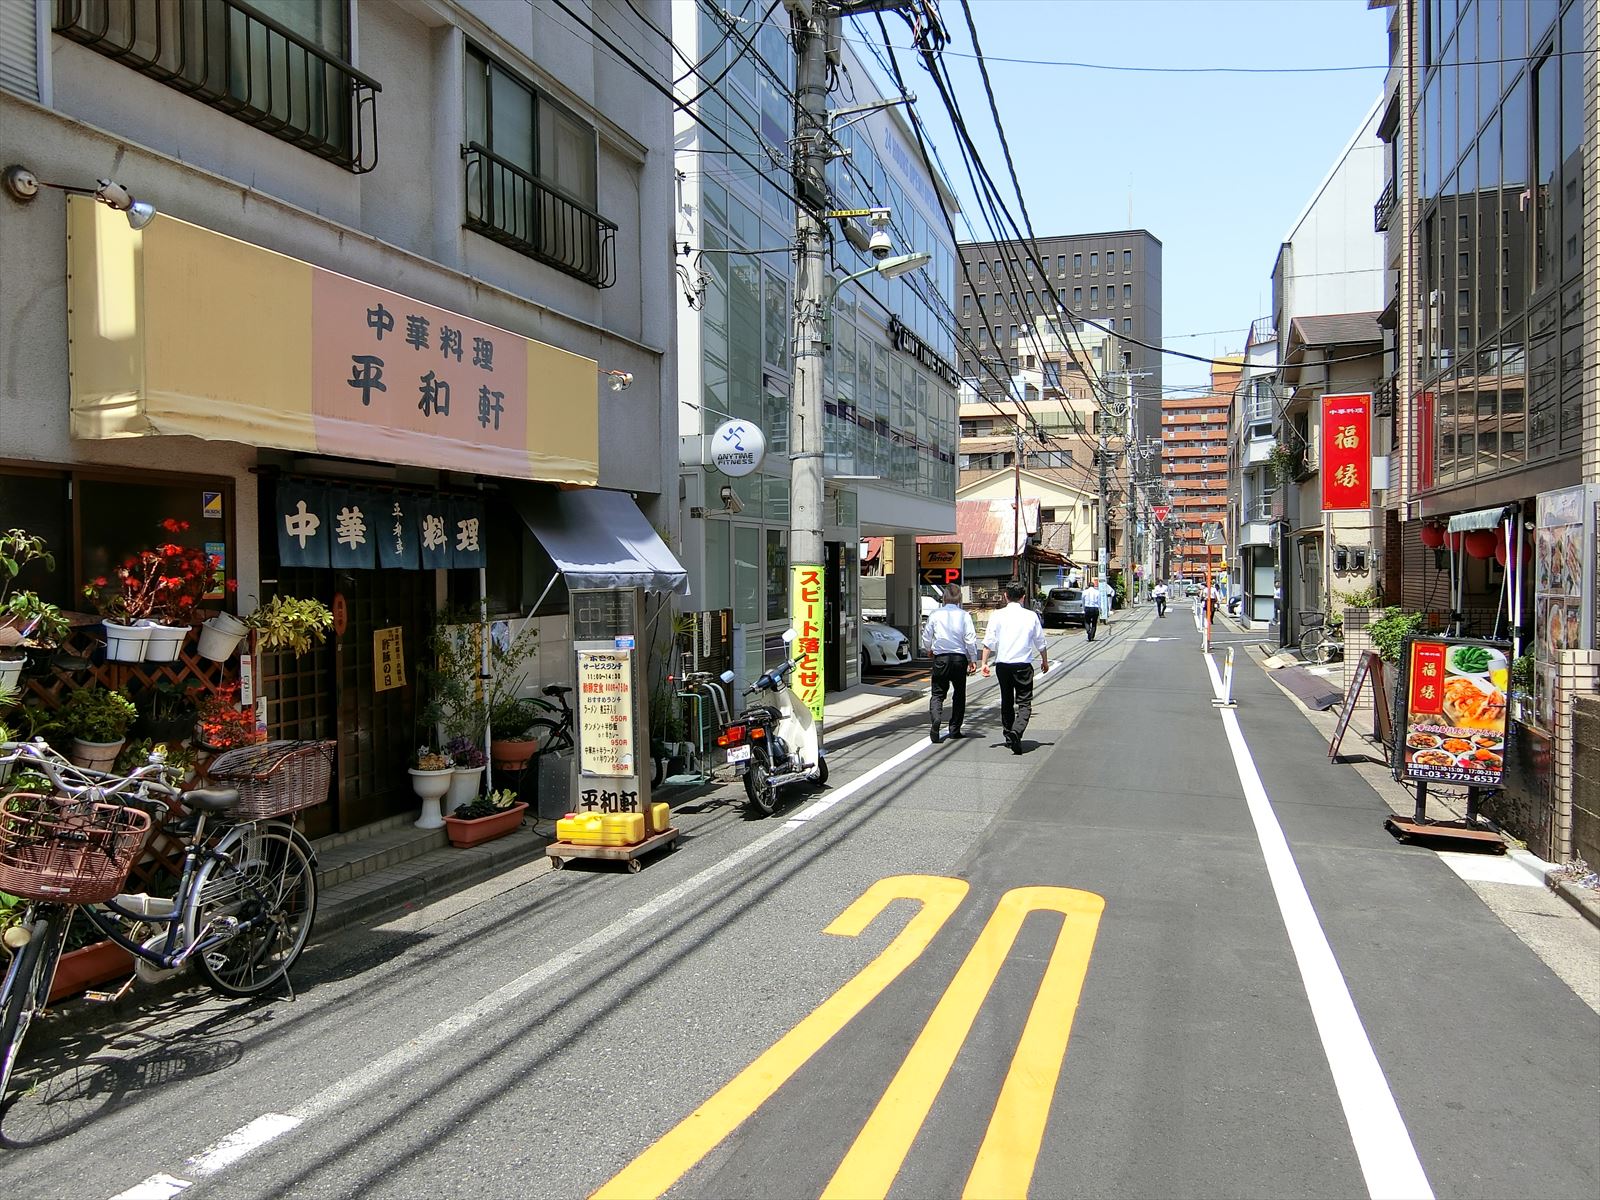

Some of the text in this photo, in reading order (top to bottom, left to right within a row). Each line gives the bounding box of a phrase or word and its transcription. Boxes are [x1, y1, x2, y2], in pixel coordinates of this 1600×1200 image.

[366, 303, 494, 372] 中華料理
[347, 354, 505, 430] 平和軒
[1334, 425, 1360, 488] 福縁
[285, 500, 480, 555] 中華料理
[945, 568, 959, 584] P
[583, 662, 623, 670] サービスランチ
[584, 704, 597, 713] ラーメン
[1407, 768, 1501, 784] TEL:03-3779-6537
[581, 789, 638, 813] 平和軒
